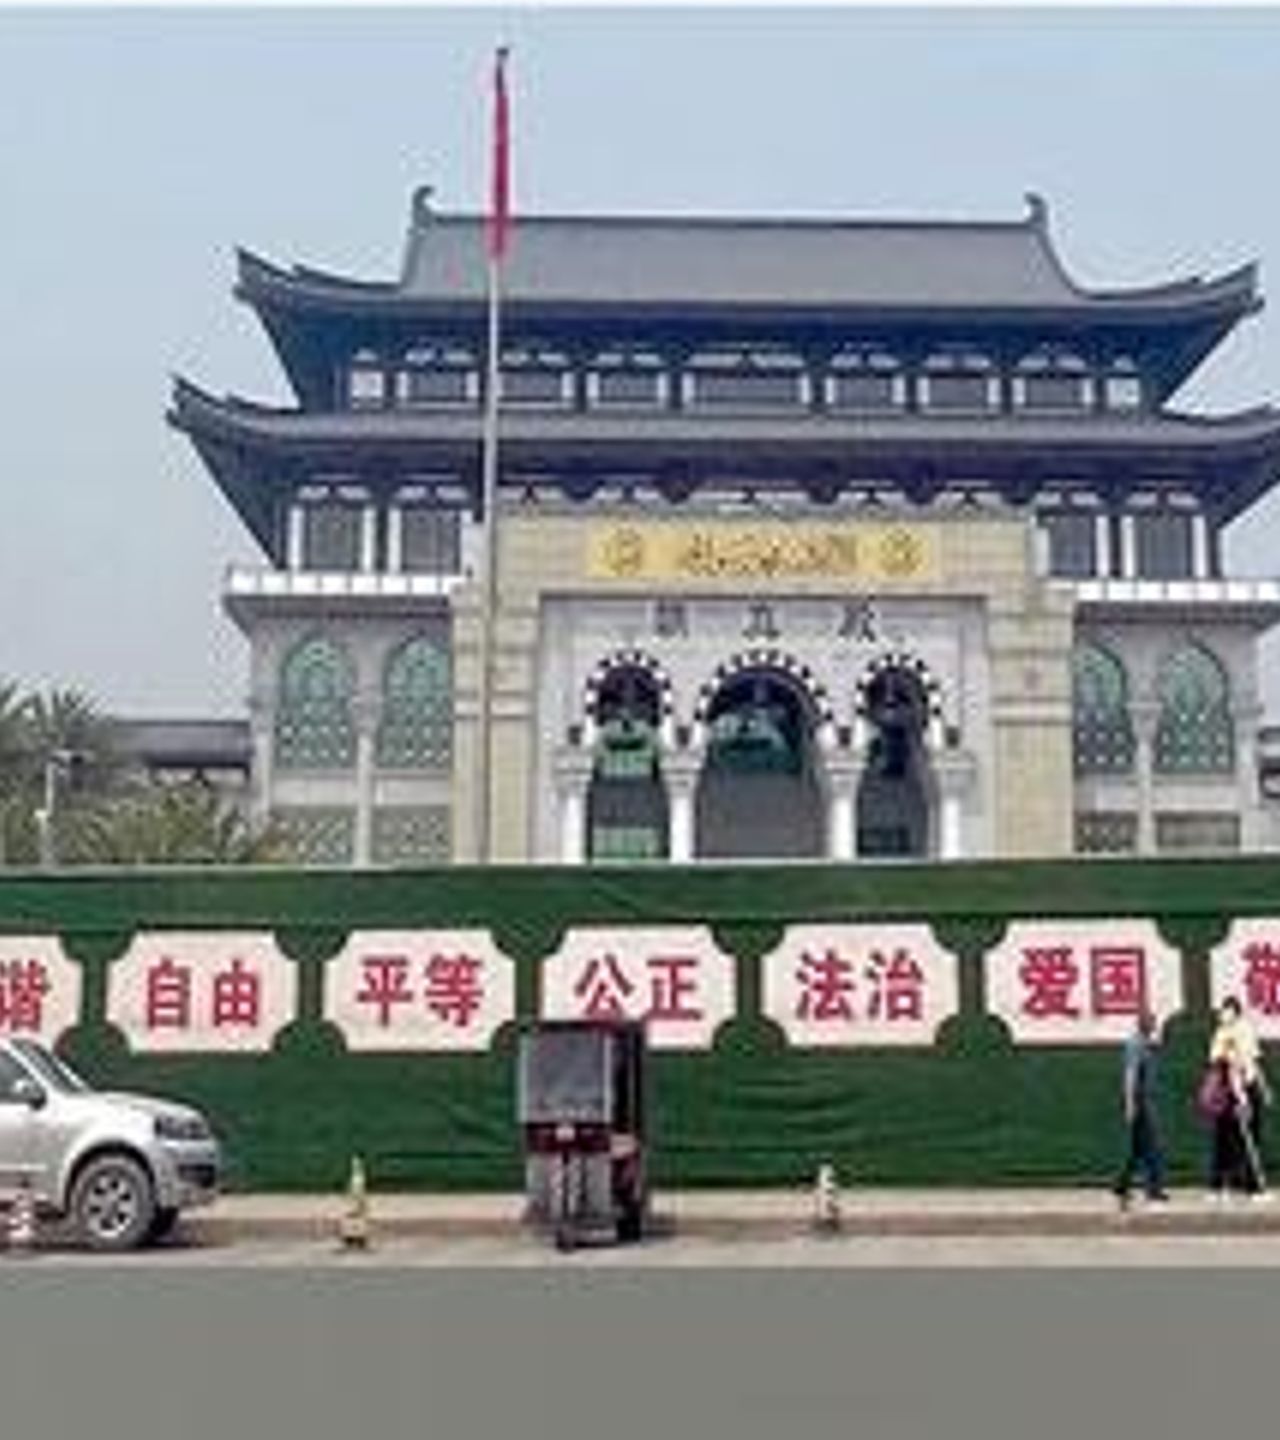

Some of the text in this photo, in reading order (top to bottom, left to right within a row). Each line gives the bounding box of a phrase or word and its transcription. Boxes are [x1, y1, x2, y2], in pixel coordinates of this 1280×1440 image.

[145, 958, 264, 1028] 自由
[356, 954, 487, 1029] 平等
[574, 953, 705, 1022] 公正
[794, 950, 927, 1021] 法治
[1017, 946, 1148, 1018] 爱国
